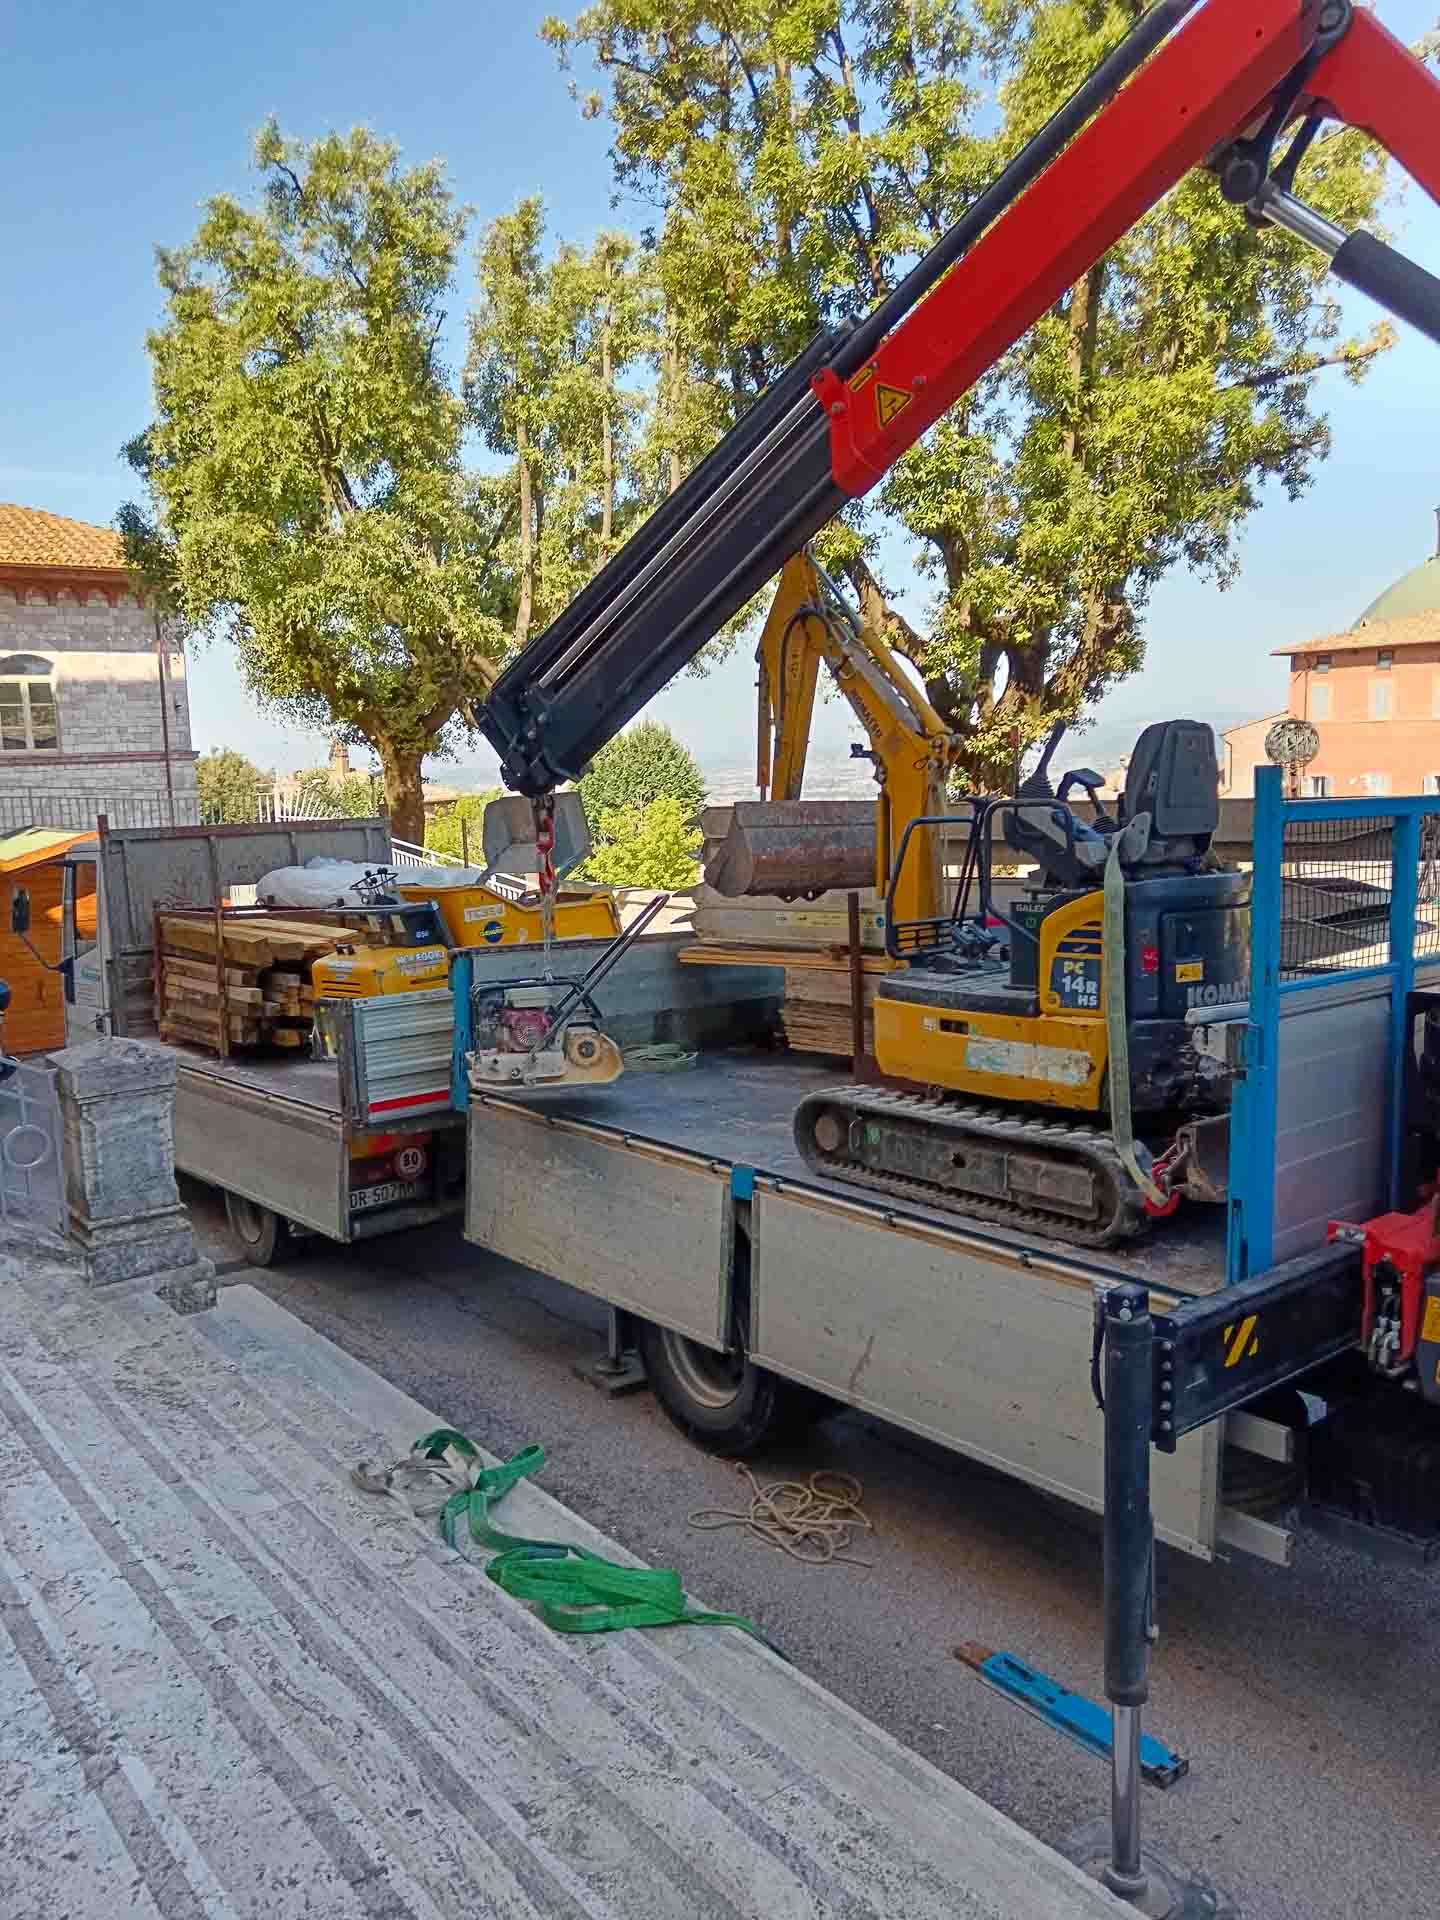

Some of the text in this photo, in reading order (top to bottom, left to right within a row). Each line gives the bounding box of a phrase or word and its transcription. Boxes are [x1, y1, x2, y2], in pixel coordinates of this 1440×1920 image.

[1063, 961, 1085, 975] PC
[1061, 975, 1098, 994] 14R
[1078, 994, 1098, 1007] HS
